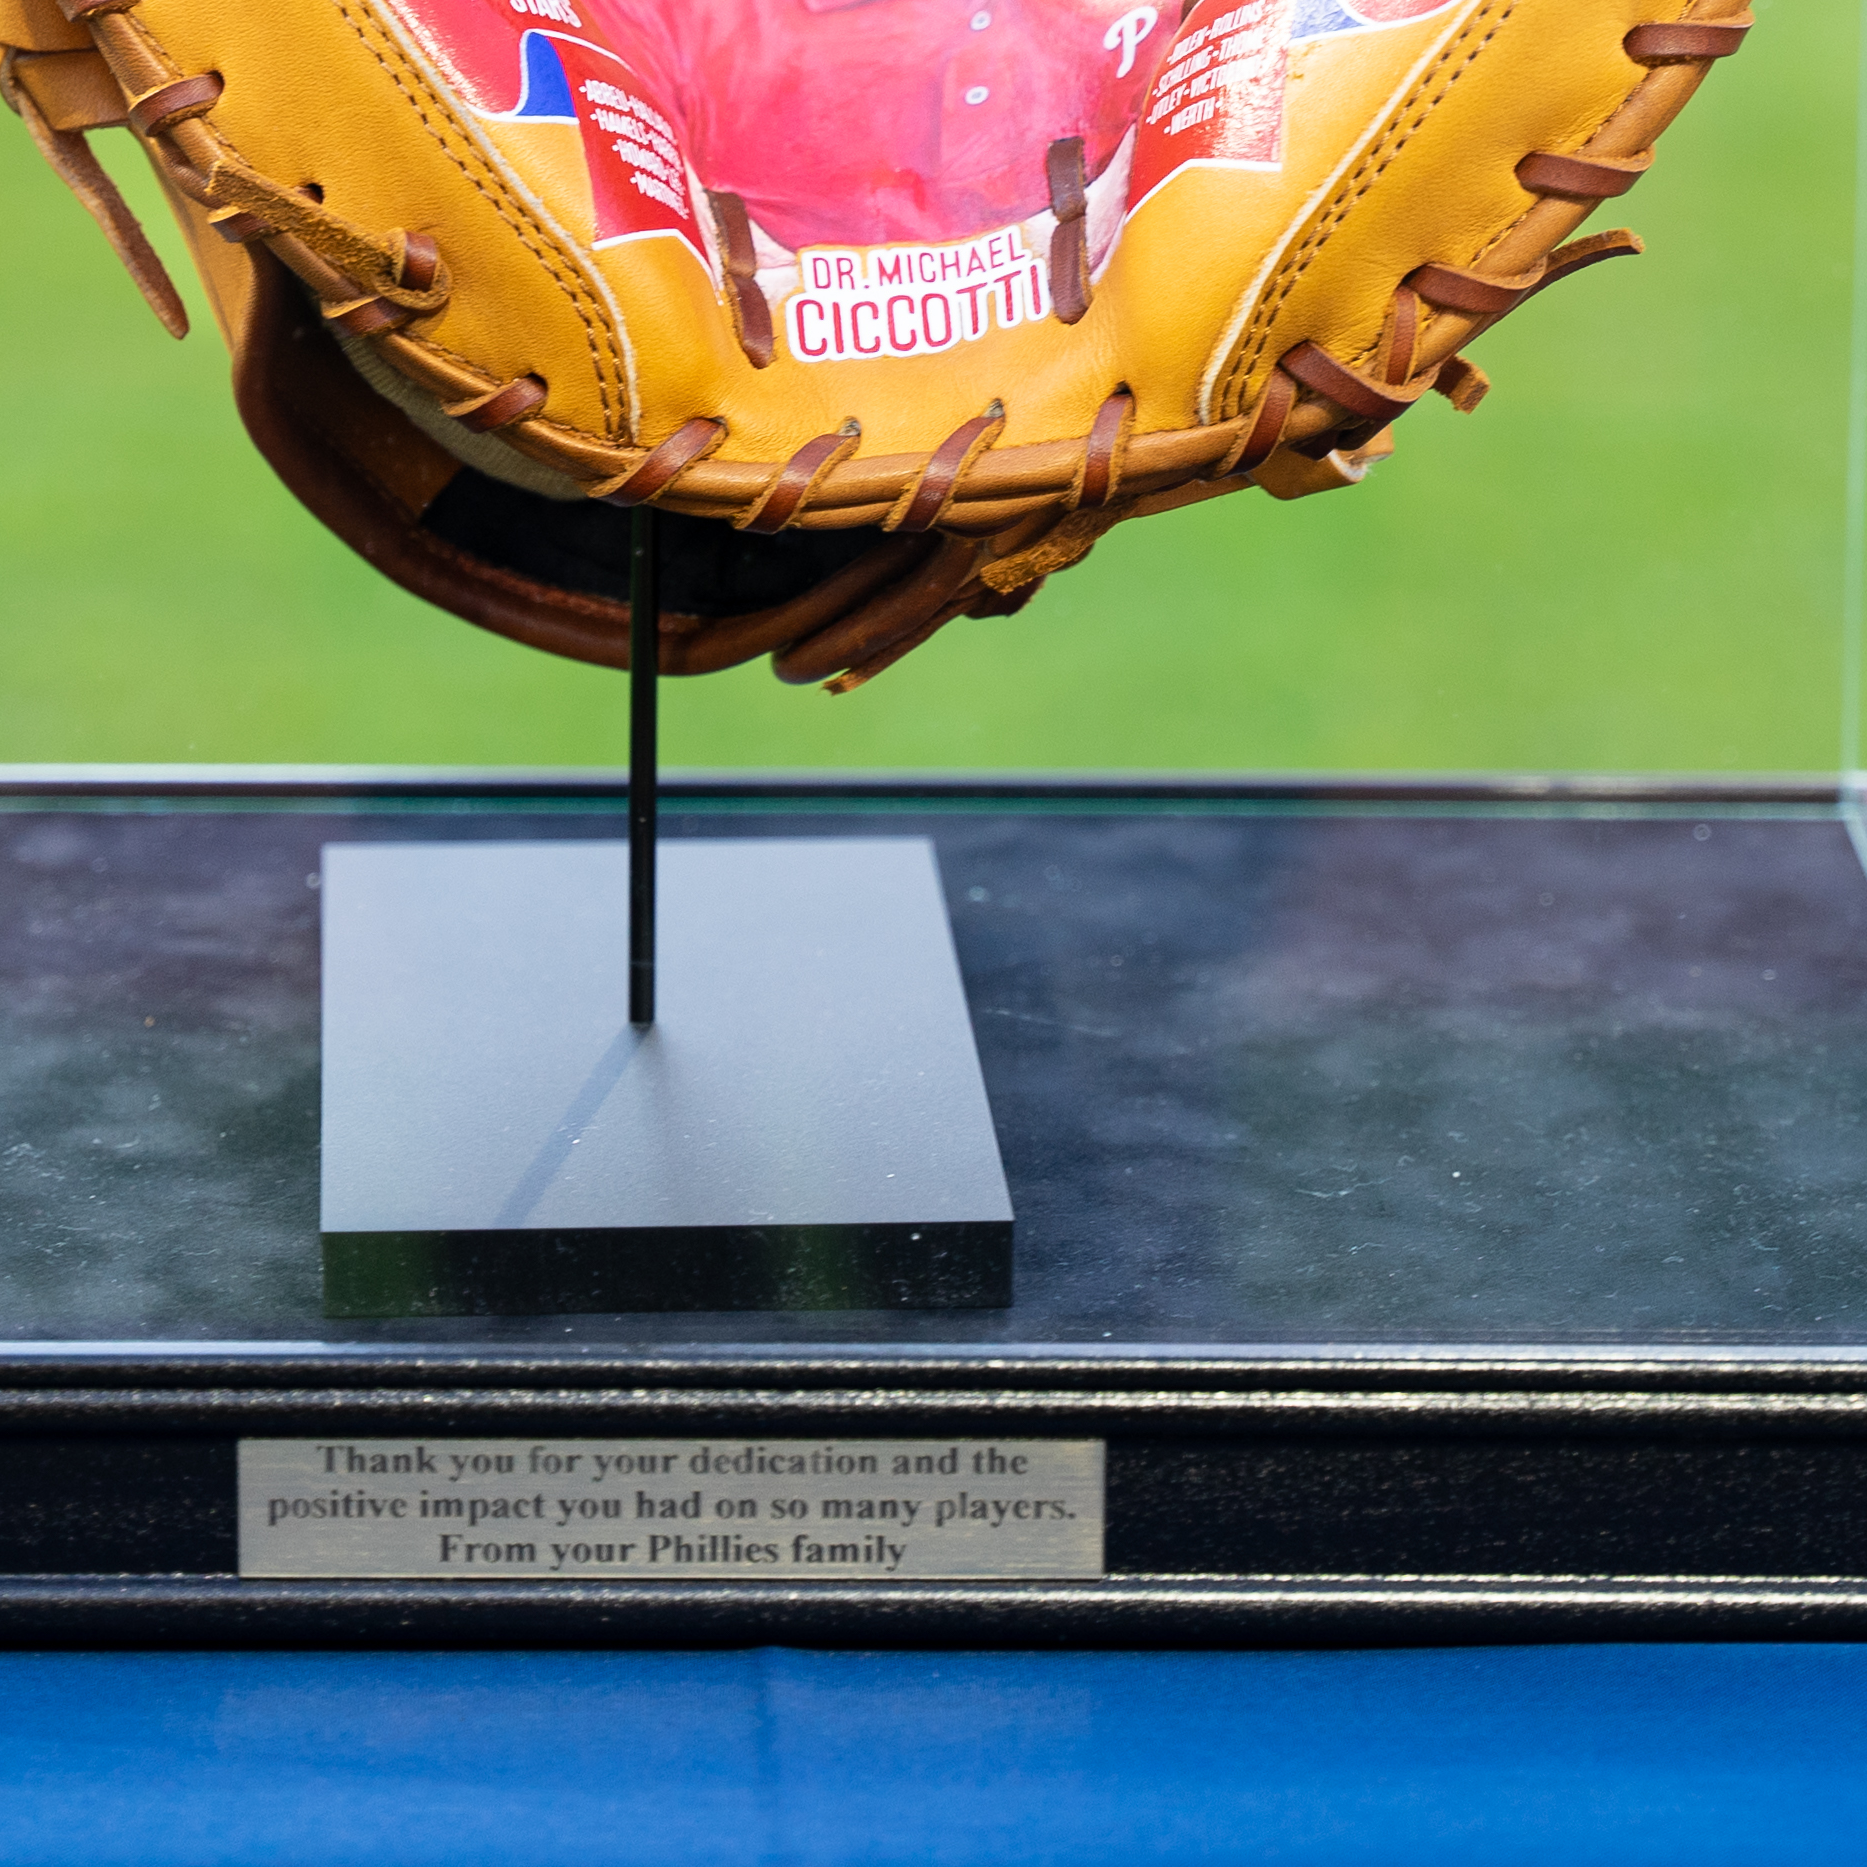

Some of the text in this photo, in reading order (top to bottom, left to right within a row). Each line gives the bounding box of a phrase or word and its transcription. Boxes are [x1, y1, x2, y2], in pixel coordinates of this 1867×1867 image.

[812, 232, 1025, 290] DR. MICHAEL
[796, 265, 1041, 357] CICCOTTI
[316, 1446, 1029, 1482] Thank you for your dedication and the
[267, 1490, 1076, 1527] positive impact you had on so many players.
[439, 1534, 907, 1571] From your Phillies family
